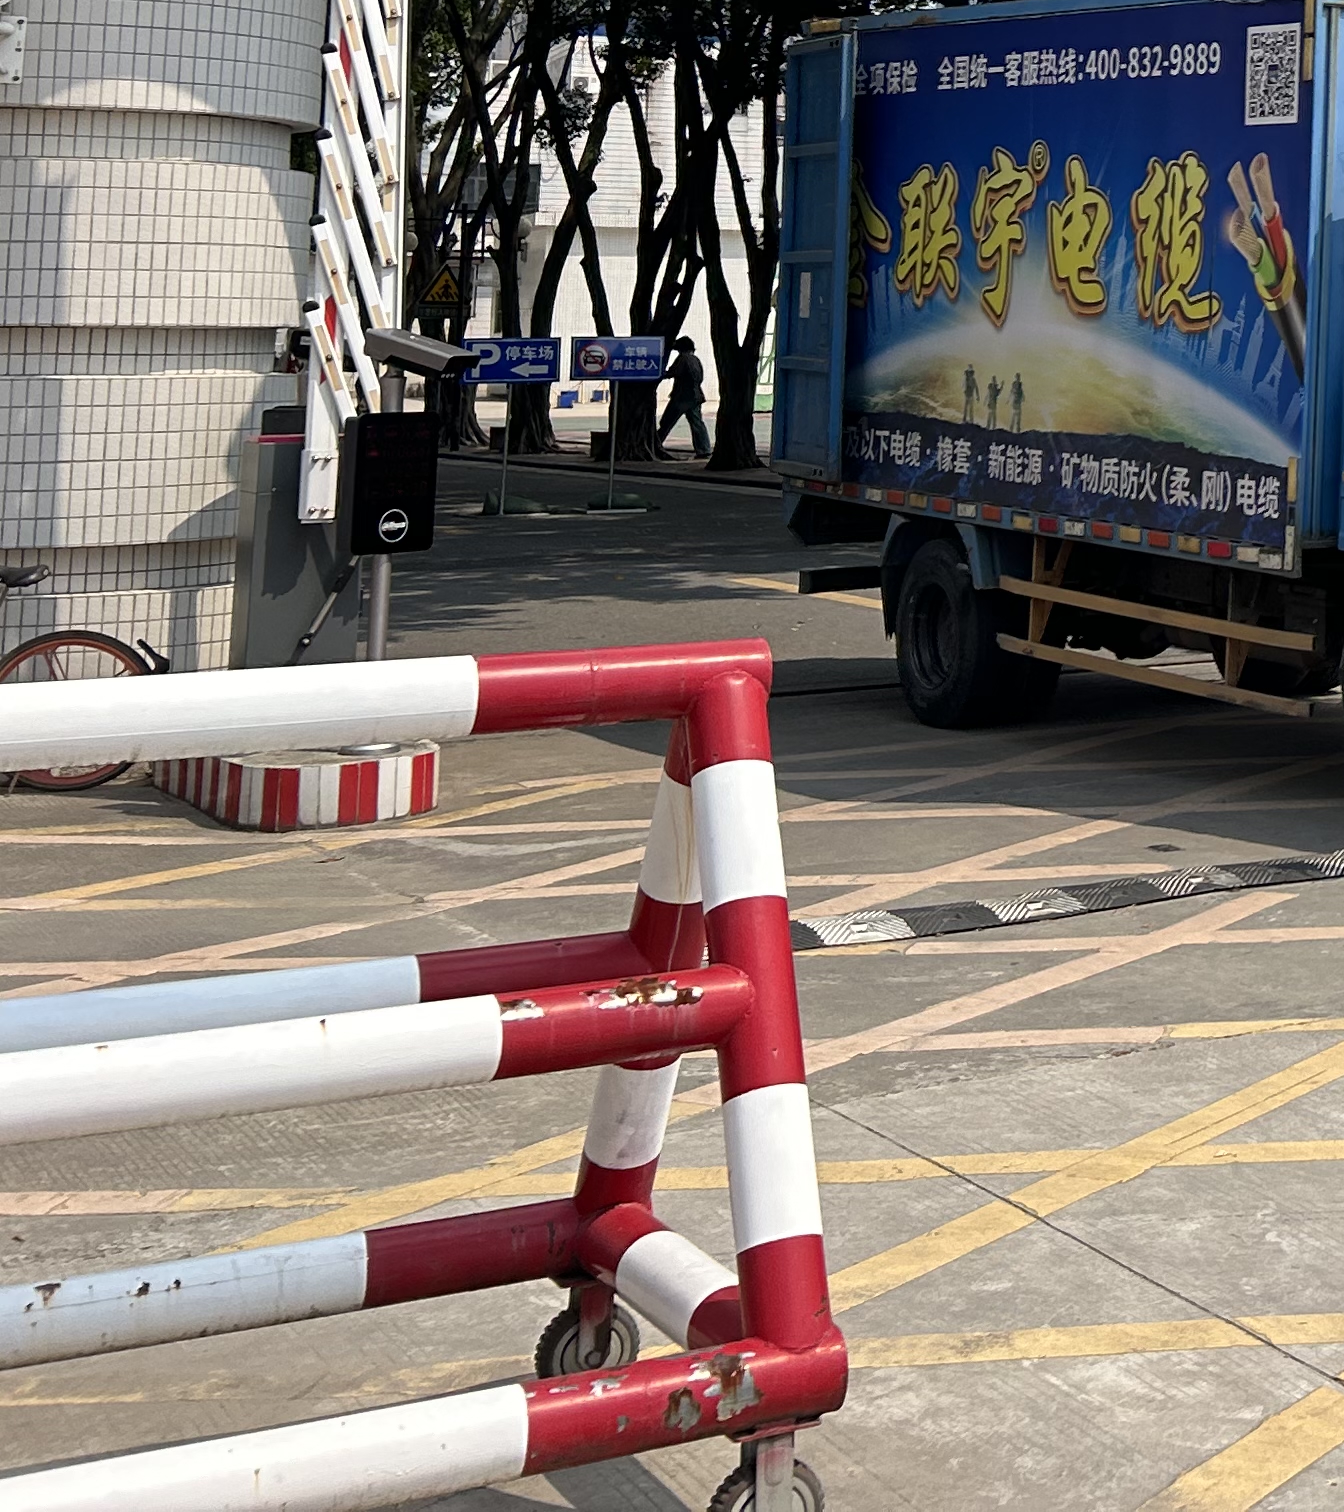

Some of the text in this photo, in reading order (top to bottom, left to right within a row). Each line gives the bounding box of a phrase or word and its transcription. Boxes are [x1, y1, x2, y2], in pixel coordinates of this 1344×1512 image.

[937, 41, 1222, 92] 全国统一客服热线:400-832-9889
[505, 345, 554, 361] 停车场
[624, 345, 648, 357] 车辆
[471, 343, 501, 378] P
[612, 360, 659, 372] 禁止驶入
